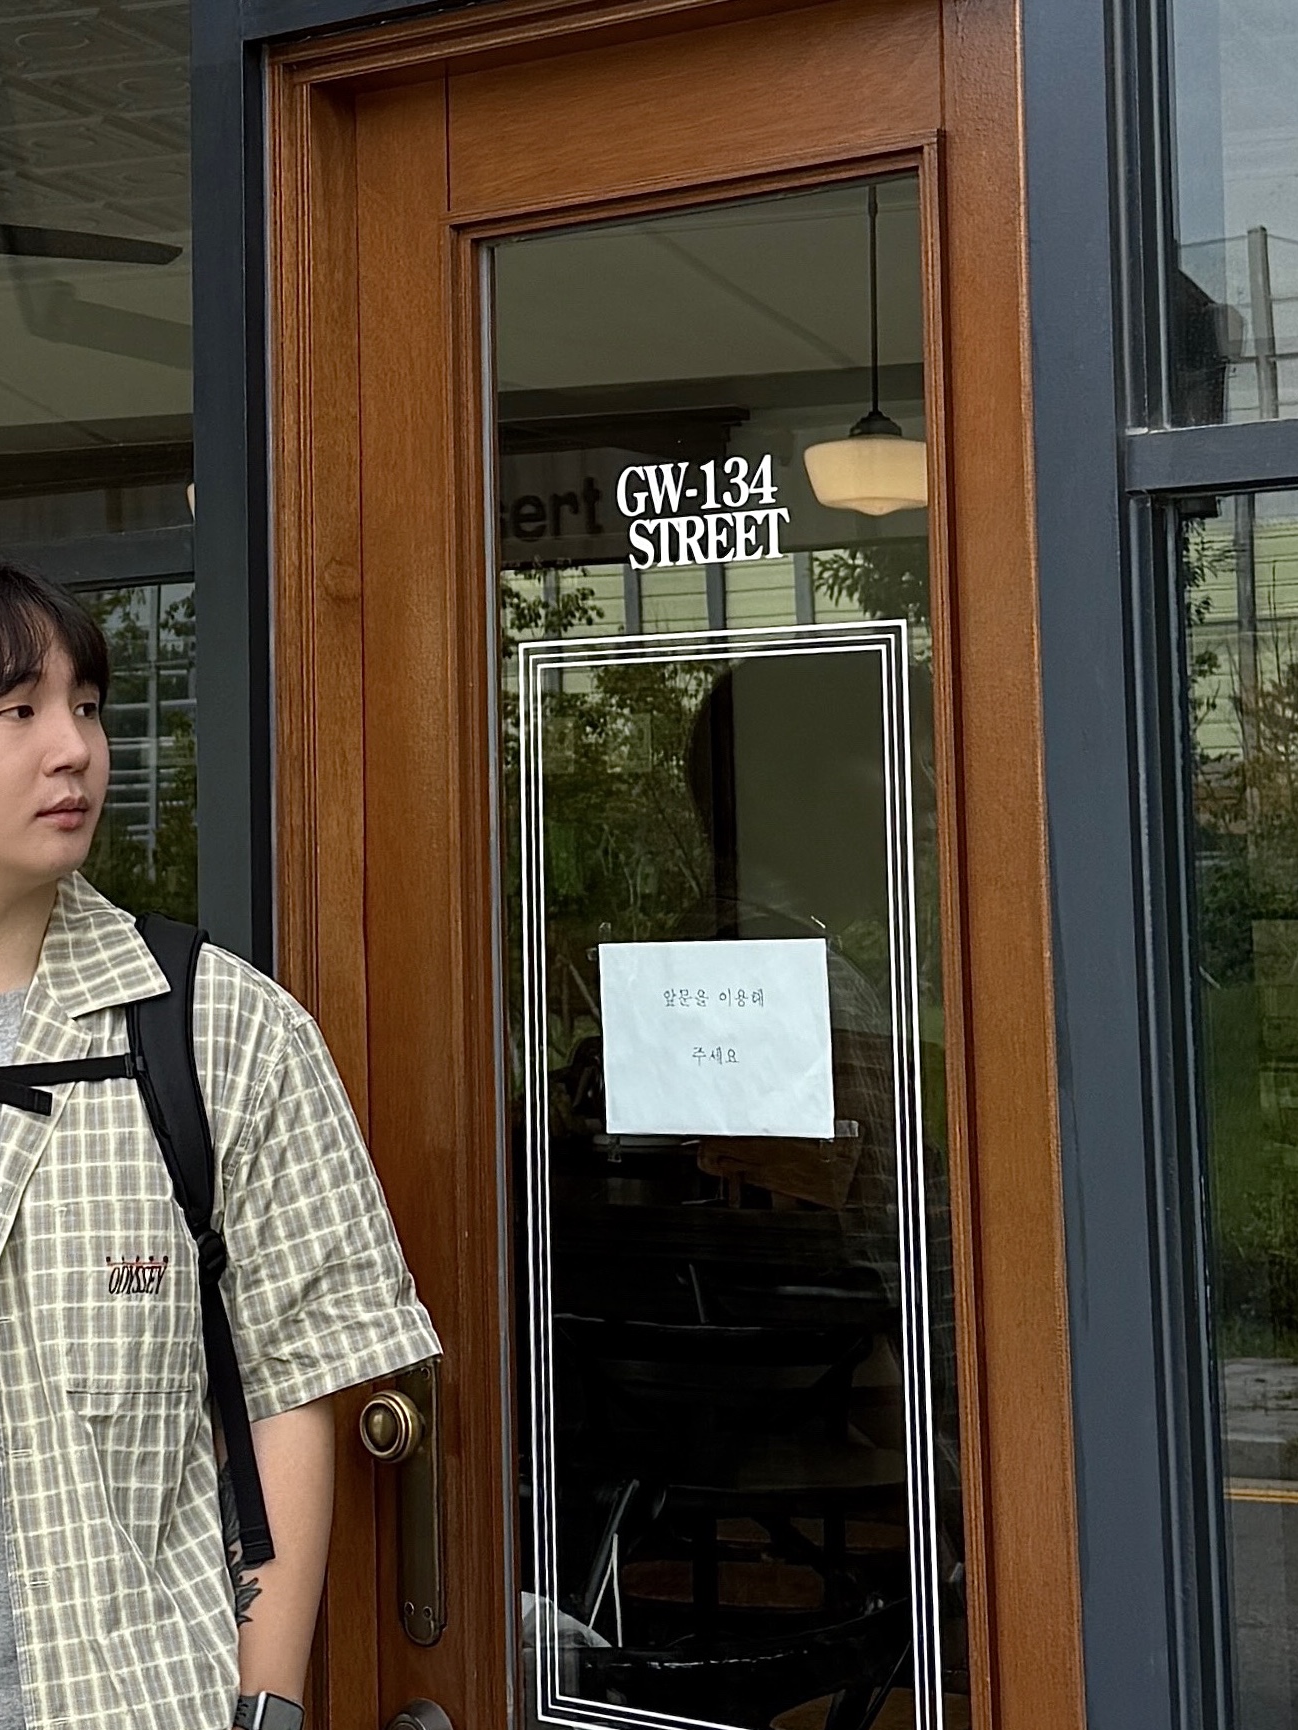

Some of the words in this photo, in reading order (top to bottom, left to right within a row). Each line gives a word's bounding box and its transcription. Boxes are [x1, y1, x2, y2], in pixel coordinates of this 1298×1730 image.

[617, 454, 778, 517] GW-134
[628, 507, 790, 570] STREET
[663, 988, 710, 1007] 앞문을
[692, 1046, 740, 1066] 주세요
[108, 1264, 168, 1295] ODYSSEY
